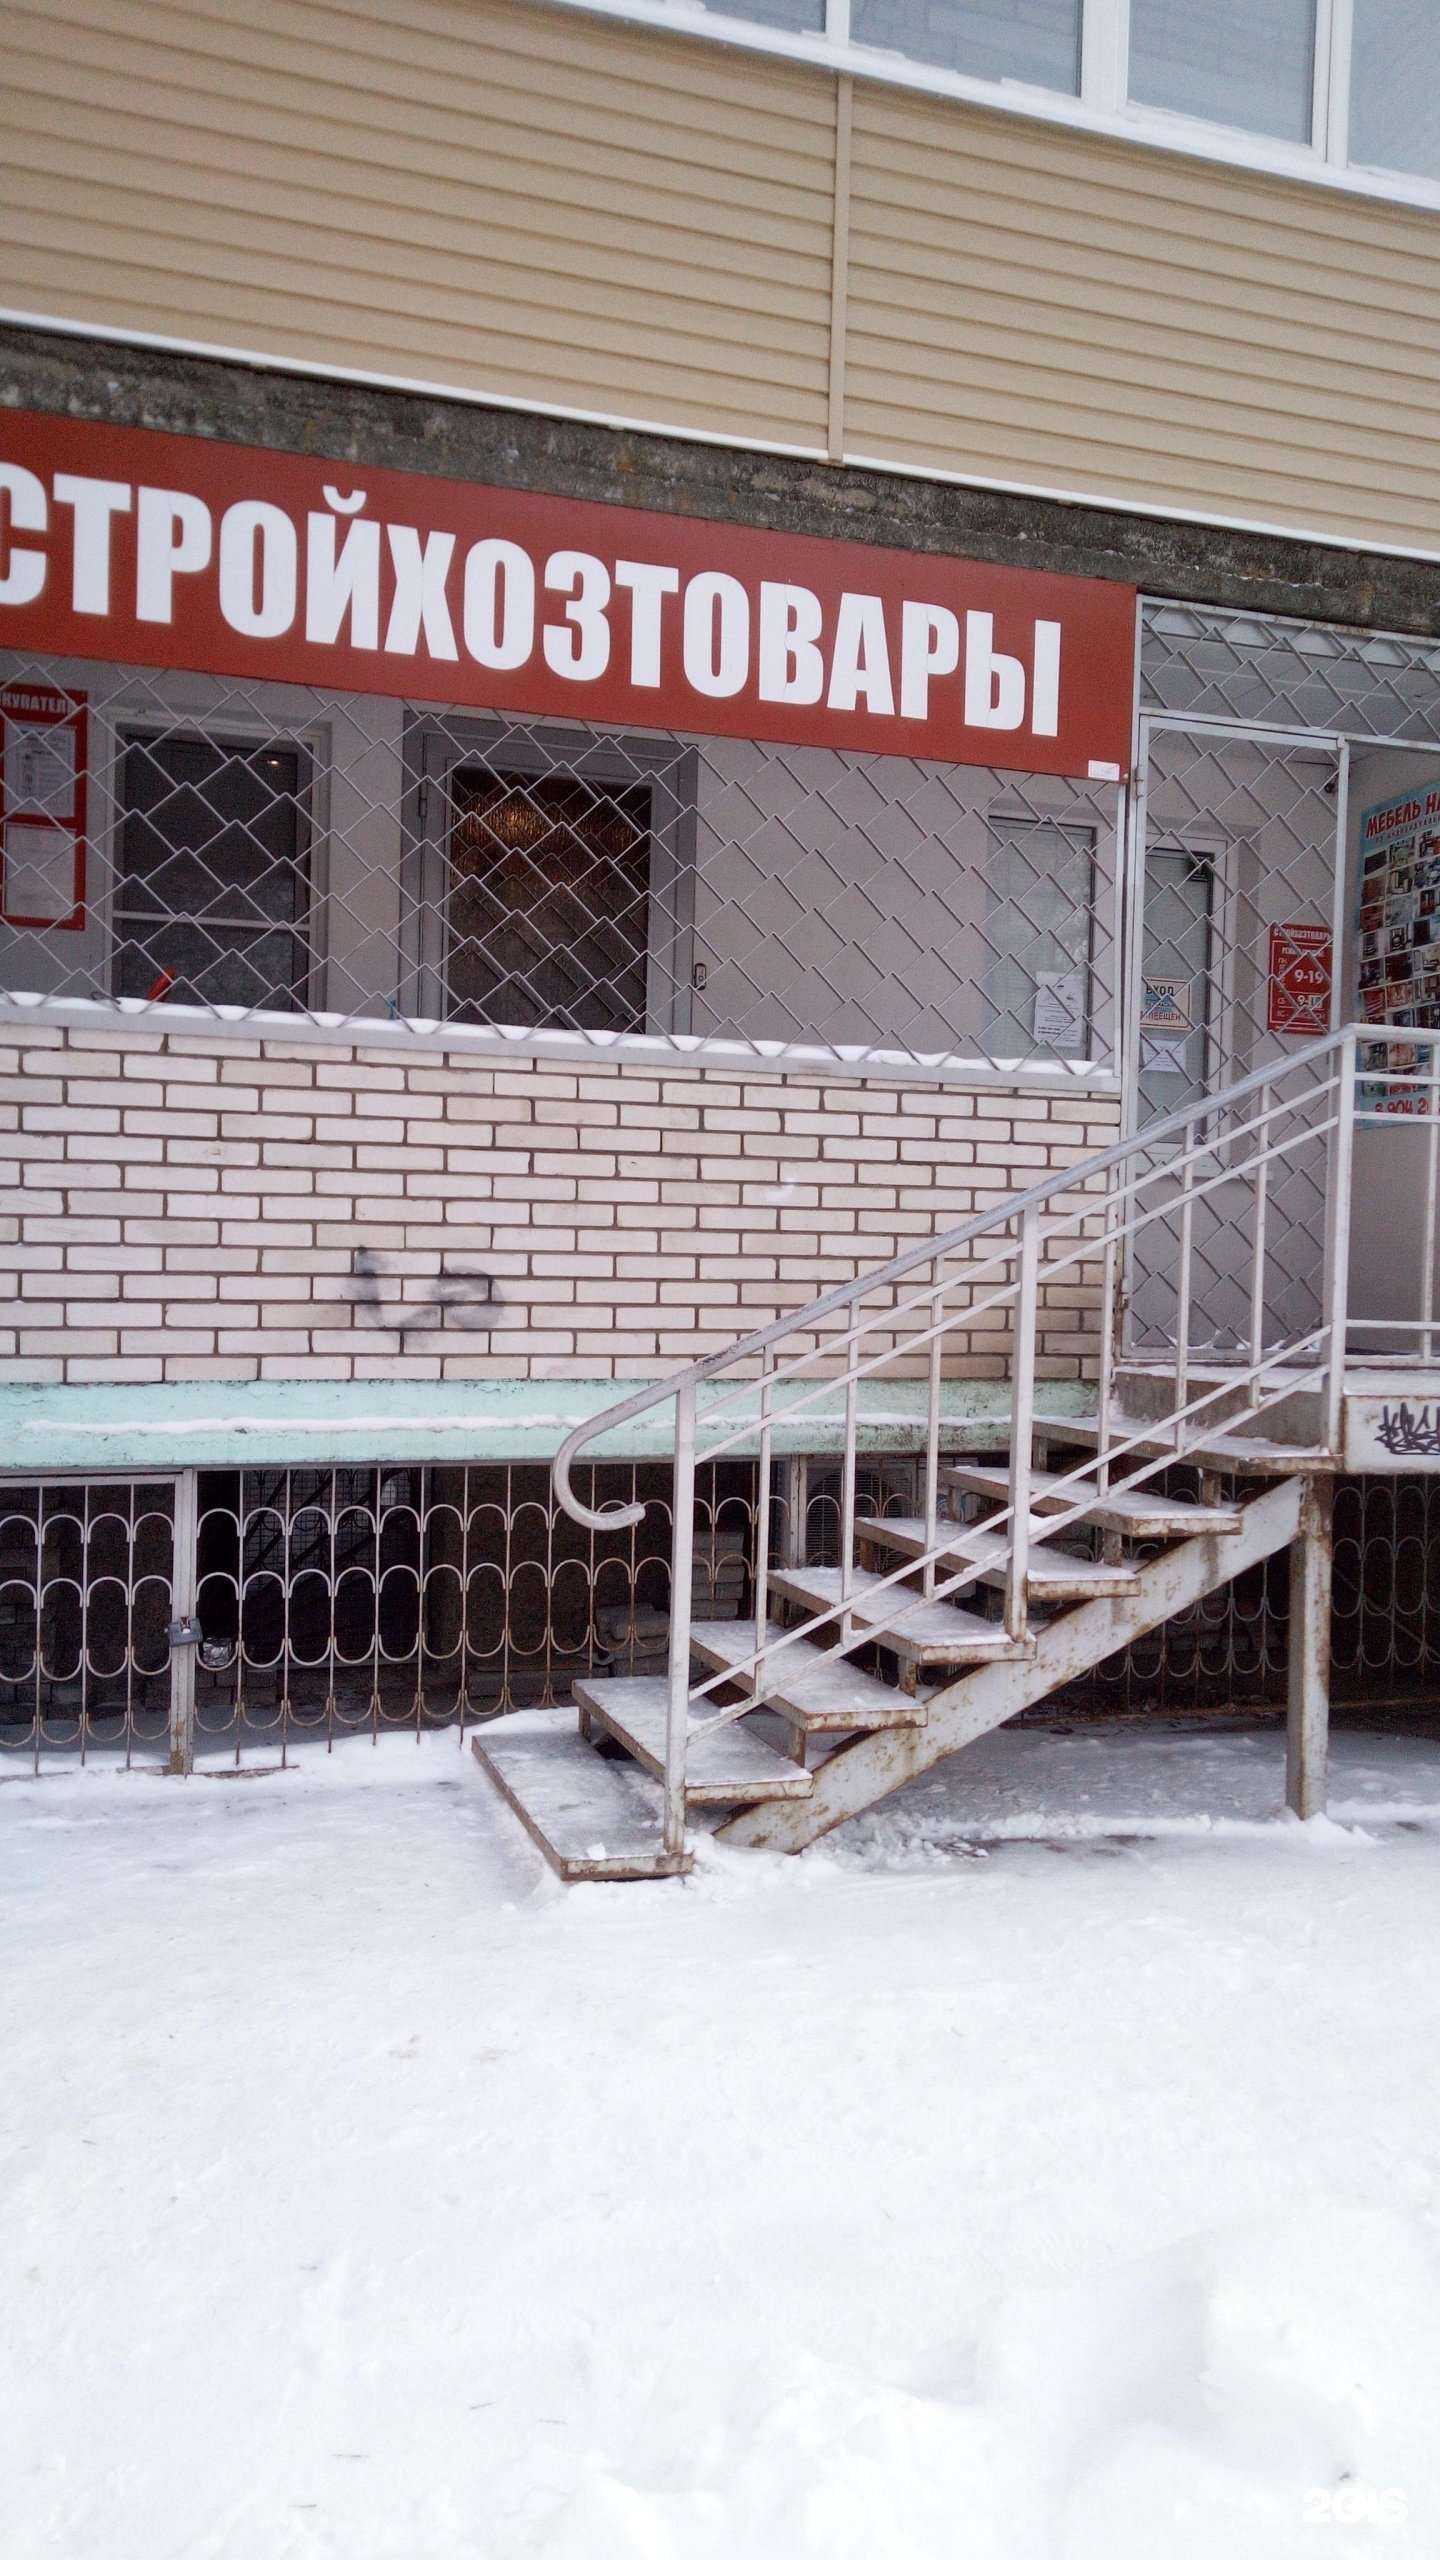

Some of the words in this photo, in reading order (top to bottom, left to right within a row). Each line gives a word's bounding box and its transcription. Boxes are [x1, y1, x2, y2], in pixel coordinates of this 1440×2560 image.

[0, 461, 1061, 737] СТРОЙХОЗТОВАРЫ
[1366, 799, 1421, 838] МЕБЕЛЬ
[1425, 791, 1440, 816] Н
[1294, 969, 1324, 984] 9-19
